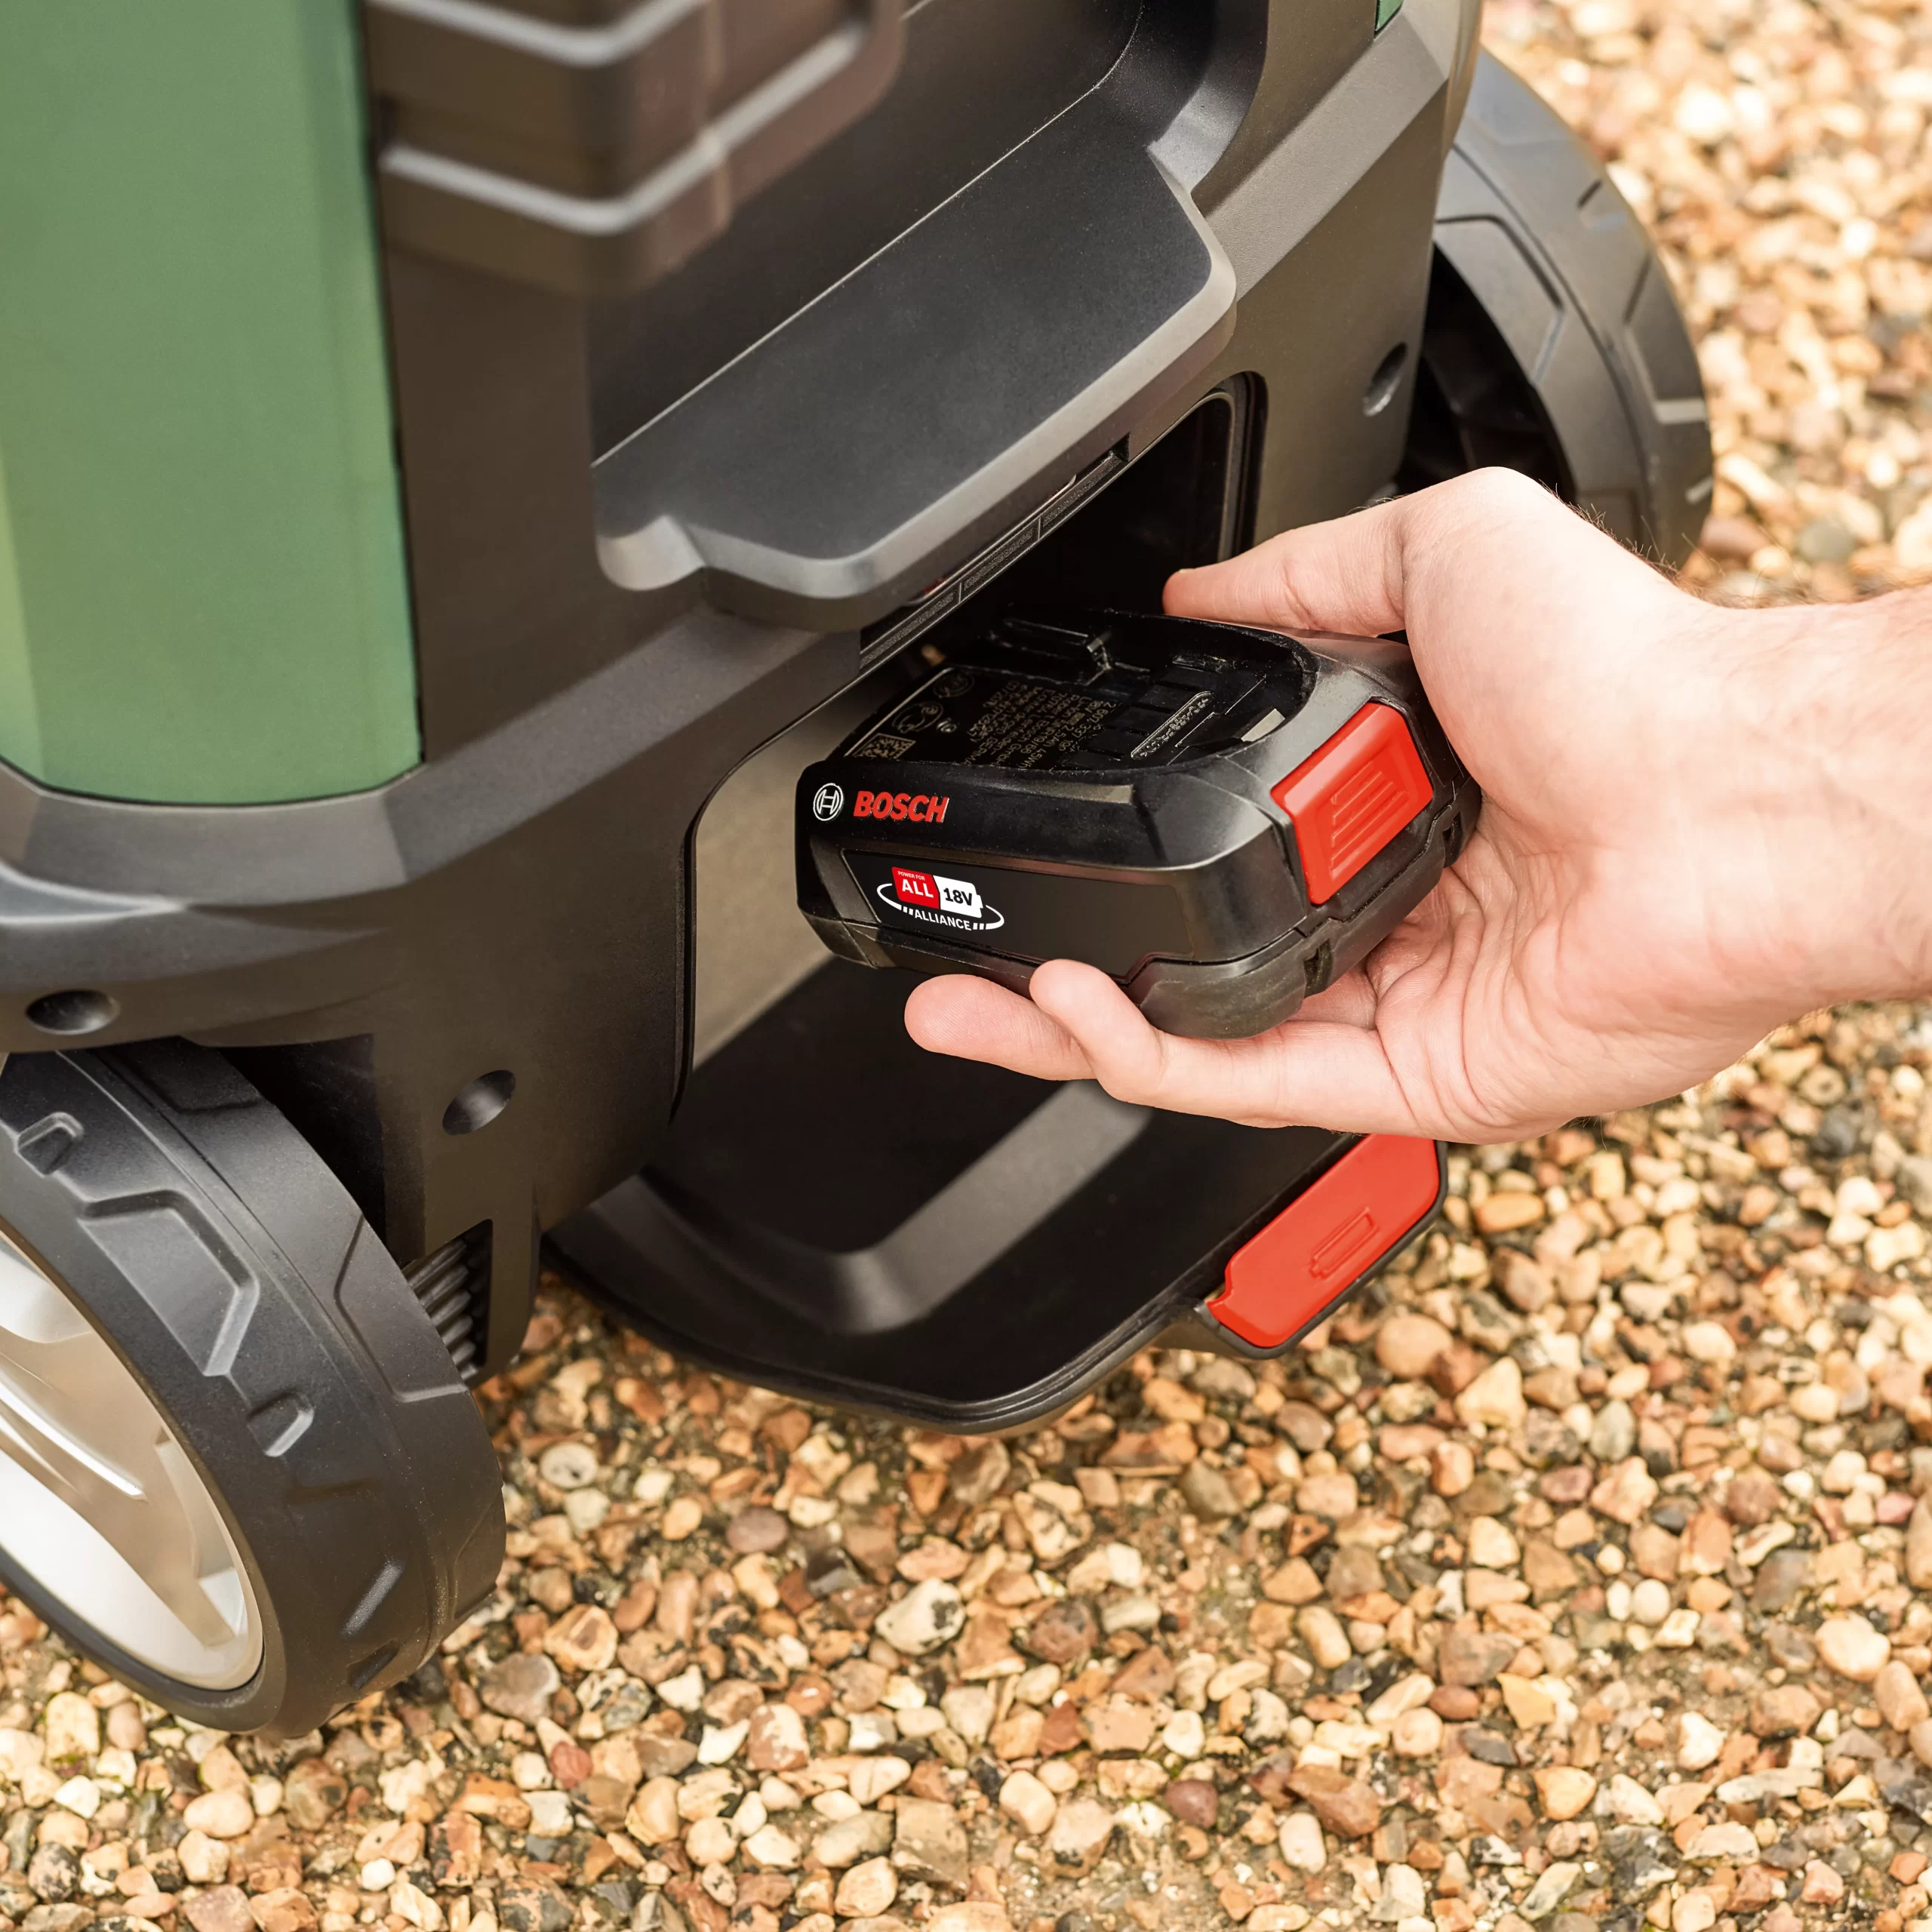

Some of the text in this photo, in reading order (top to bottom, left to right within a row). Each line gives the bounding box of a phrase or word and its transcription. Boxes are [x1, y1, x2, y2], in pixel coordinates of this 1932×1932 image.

[854, 791, 949, 823] BOSCH
[898, 871, 915, 879] POWER
[902, 879, 934, 898] ALL
[943, 888, 972, 906] 18V
[915, 909, 972, 931] ALLIANCE
